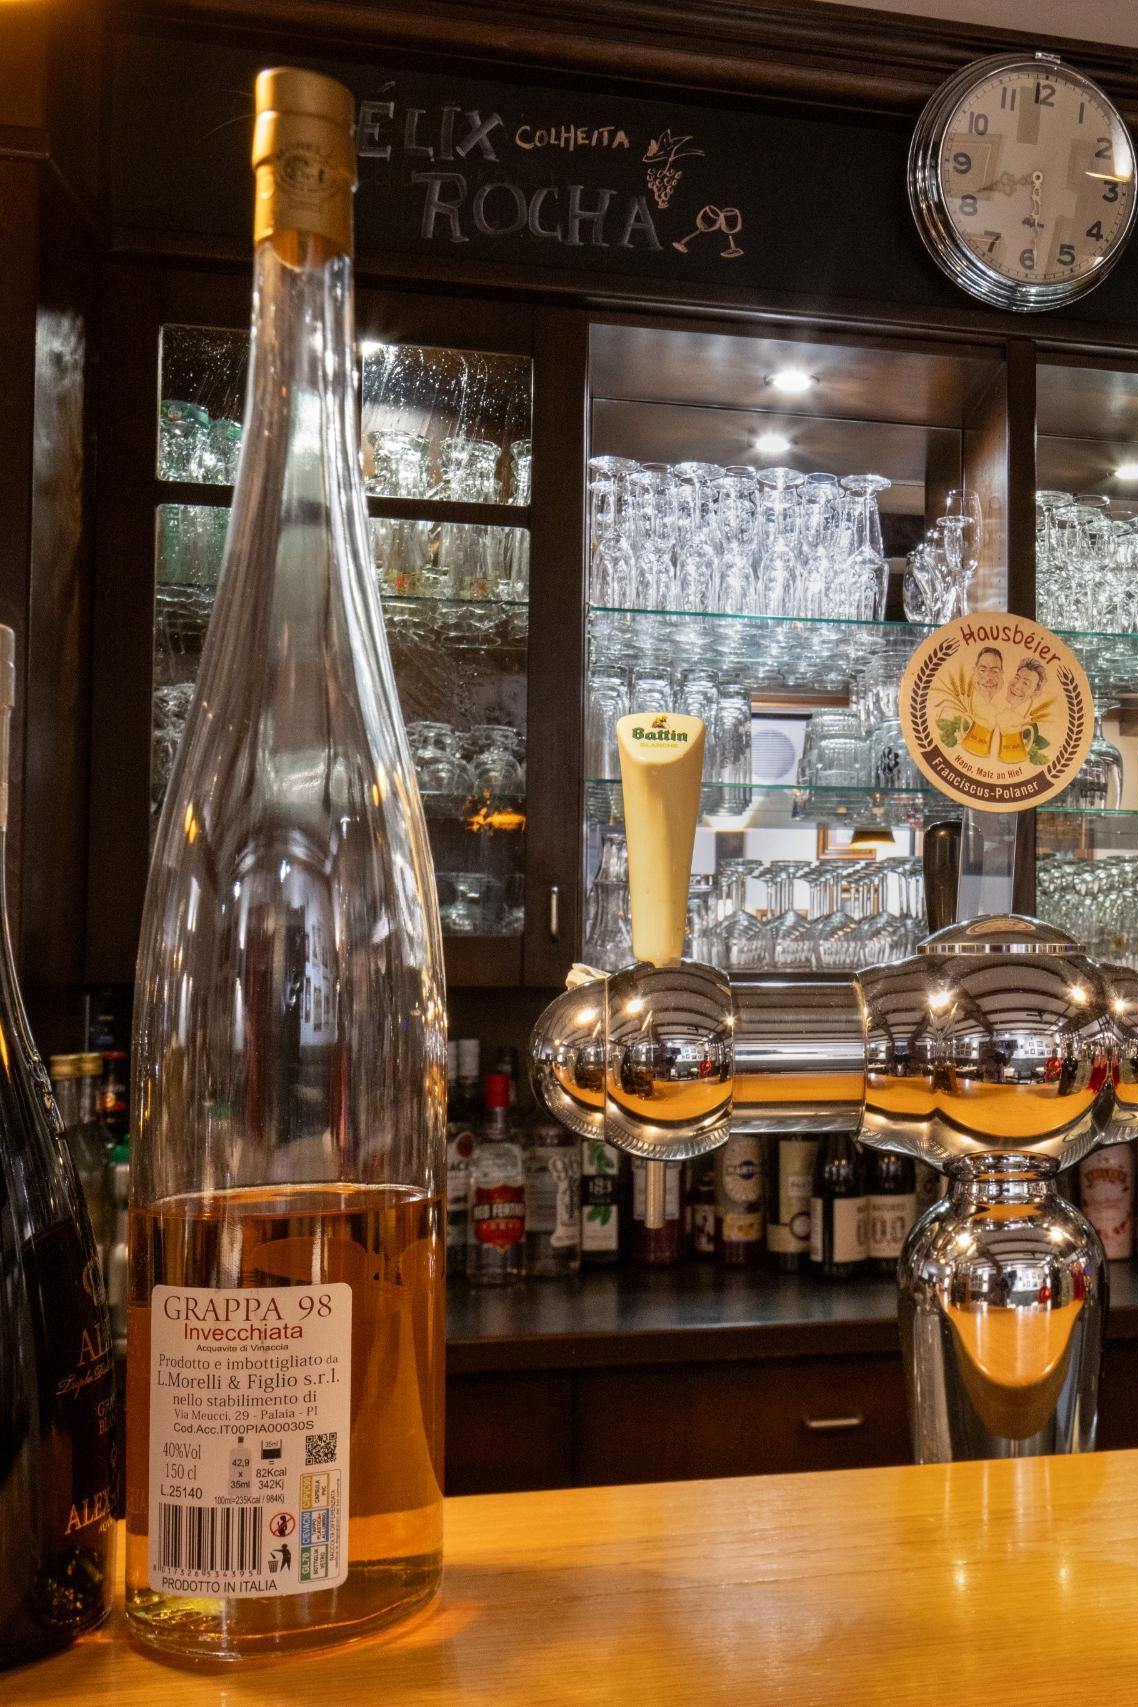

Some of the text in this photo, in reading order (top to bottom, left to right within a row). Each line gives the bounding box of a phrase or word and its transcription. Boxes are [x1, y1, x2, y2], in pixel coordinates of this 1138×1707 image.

[1001, 86, 1017, 111] 11
[1034, 82, 1056, 108] 12
[358, 81, 630, 162] ÉLIX COLHEITA
[968, 111, 989, 136] 10
[1078, 102, 1085, 124] 1
[1094, 137, 1113, 160] 2
[952, 152, 972, 174] 9
[1102, 180, 1119, 202] 3
[411, 171, 664, 251] ROCHA
[958, 194, 978, 216] 8
[983, 230, 1001, 253] 7
[1086, 220, 1104, 242] 4
[1019, 248, 1036, 270] 6
[1056, 244, 1076, 266] 5
[960, 623, 1061, 665] Hausbéier
[632, 727, 688, 742] Battin
[931, 757, 1039, 799] Franciscus-Polaner
[976, 767, 994, 779] Malz
[163, 1294, 333, 1322] GRAPPA 98
[184, 1322, 303, 1342] Invecchiata
[196, 1343, 289, 1353] Acquavite di Vinaccia
[159, 1353, 339, 1372] Prodotto e imbottigliato da
[228, 1375, 241, 1390] &
[248, 1374, 298, 1393] Figlio
[303, 1367, 340, 1386] s.r.l.
[173, 1390, 318, 1408] nello stabilimento di
[174, 1408, 190, 1420] Via
[235, 1410, 250, 1421] 29
[260, 1408, 296, 1420] Palaia
[306, 1406, 318, 1416] PI
[162, 1442, 201, 1460] 40%Vol
[264, 1440, 279, 1448] 35ml
[165, 1463, 198, 1481] 150 cl
[231, 1458, 250, 1468] 42,9
[255, 1467, 287, 1478] 82Kcal
[160, 1484, 203, 1500] L.25140
[230, 1480, 250, 1489] 35ml
[258, 1480, 285, 1490] 342Kj
[162, 1576, 278, 1593] PRODOTTO IN ITALIA
